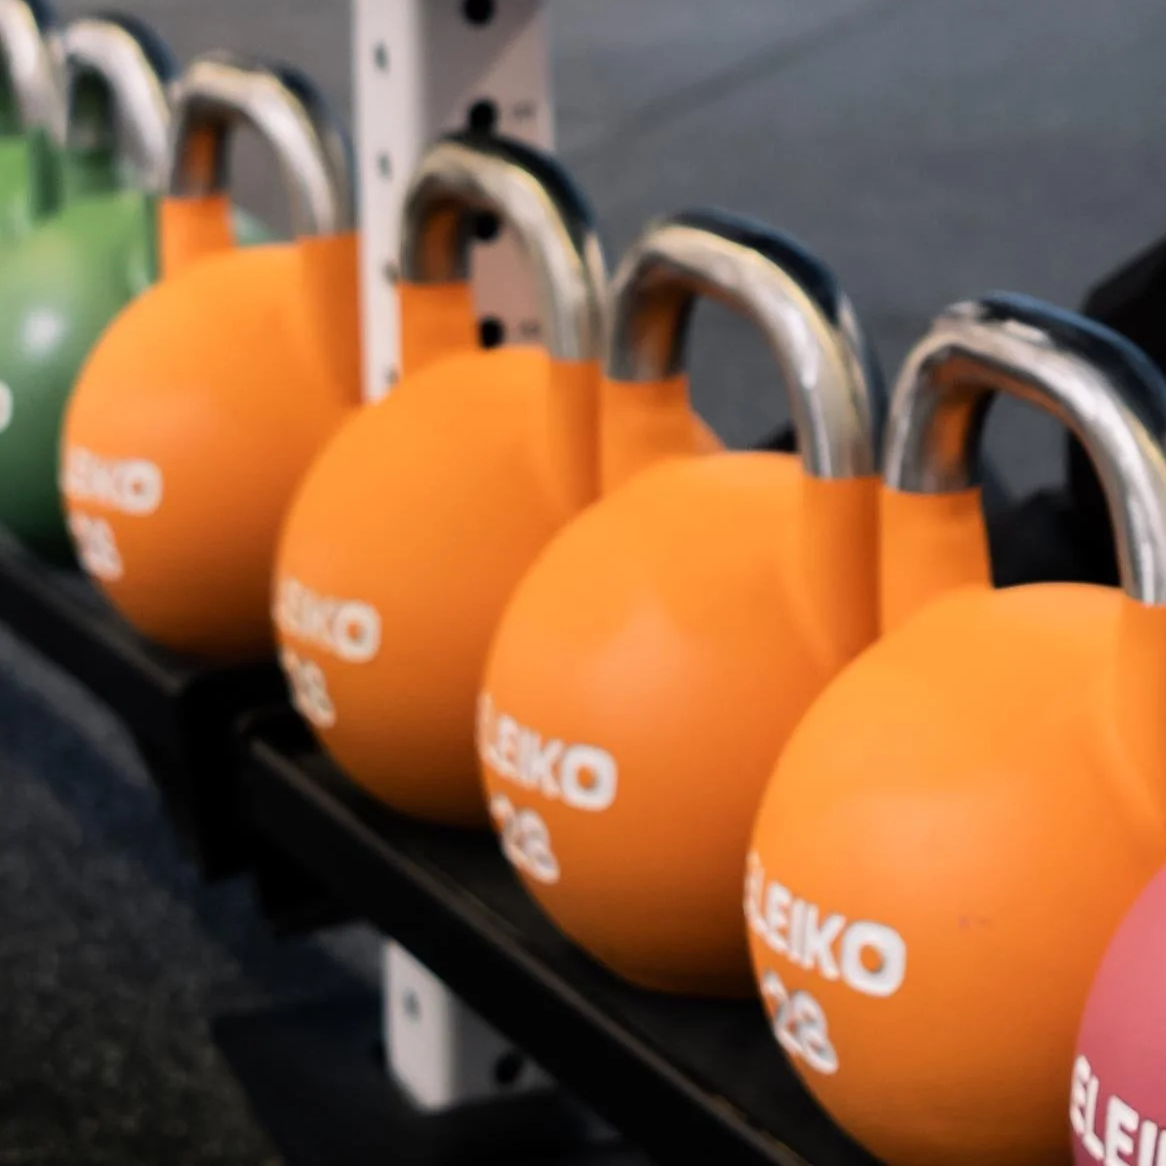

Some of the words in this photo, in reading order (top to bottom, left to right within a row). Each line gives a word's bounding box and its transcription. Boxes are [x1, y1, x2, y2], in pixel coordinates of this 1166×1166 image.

[478, 691, 618, 812] LEIKO
[744, 850, 907, 998] LEIKO
[762, 969, 840, 1075] 28
